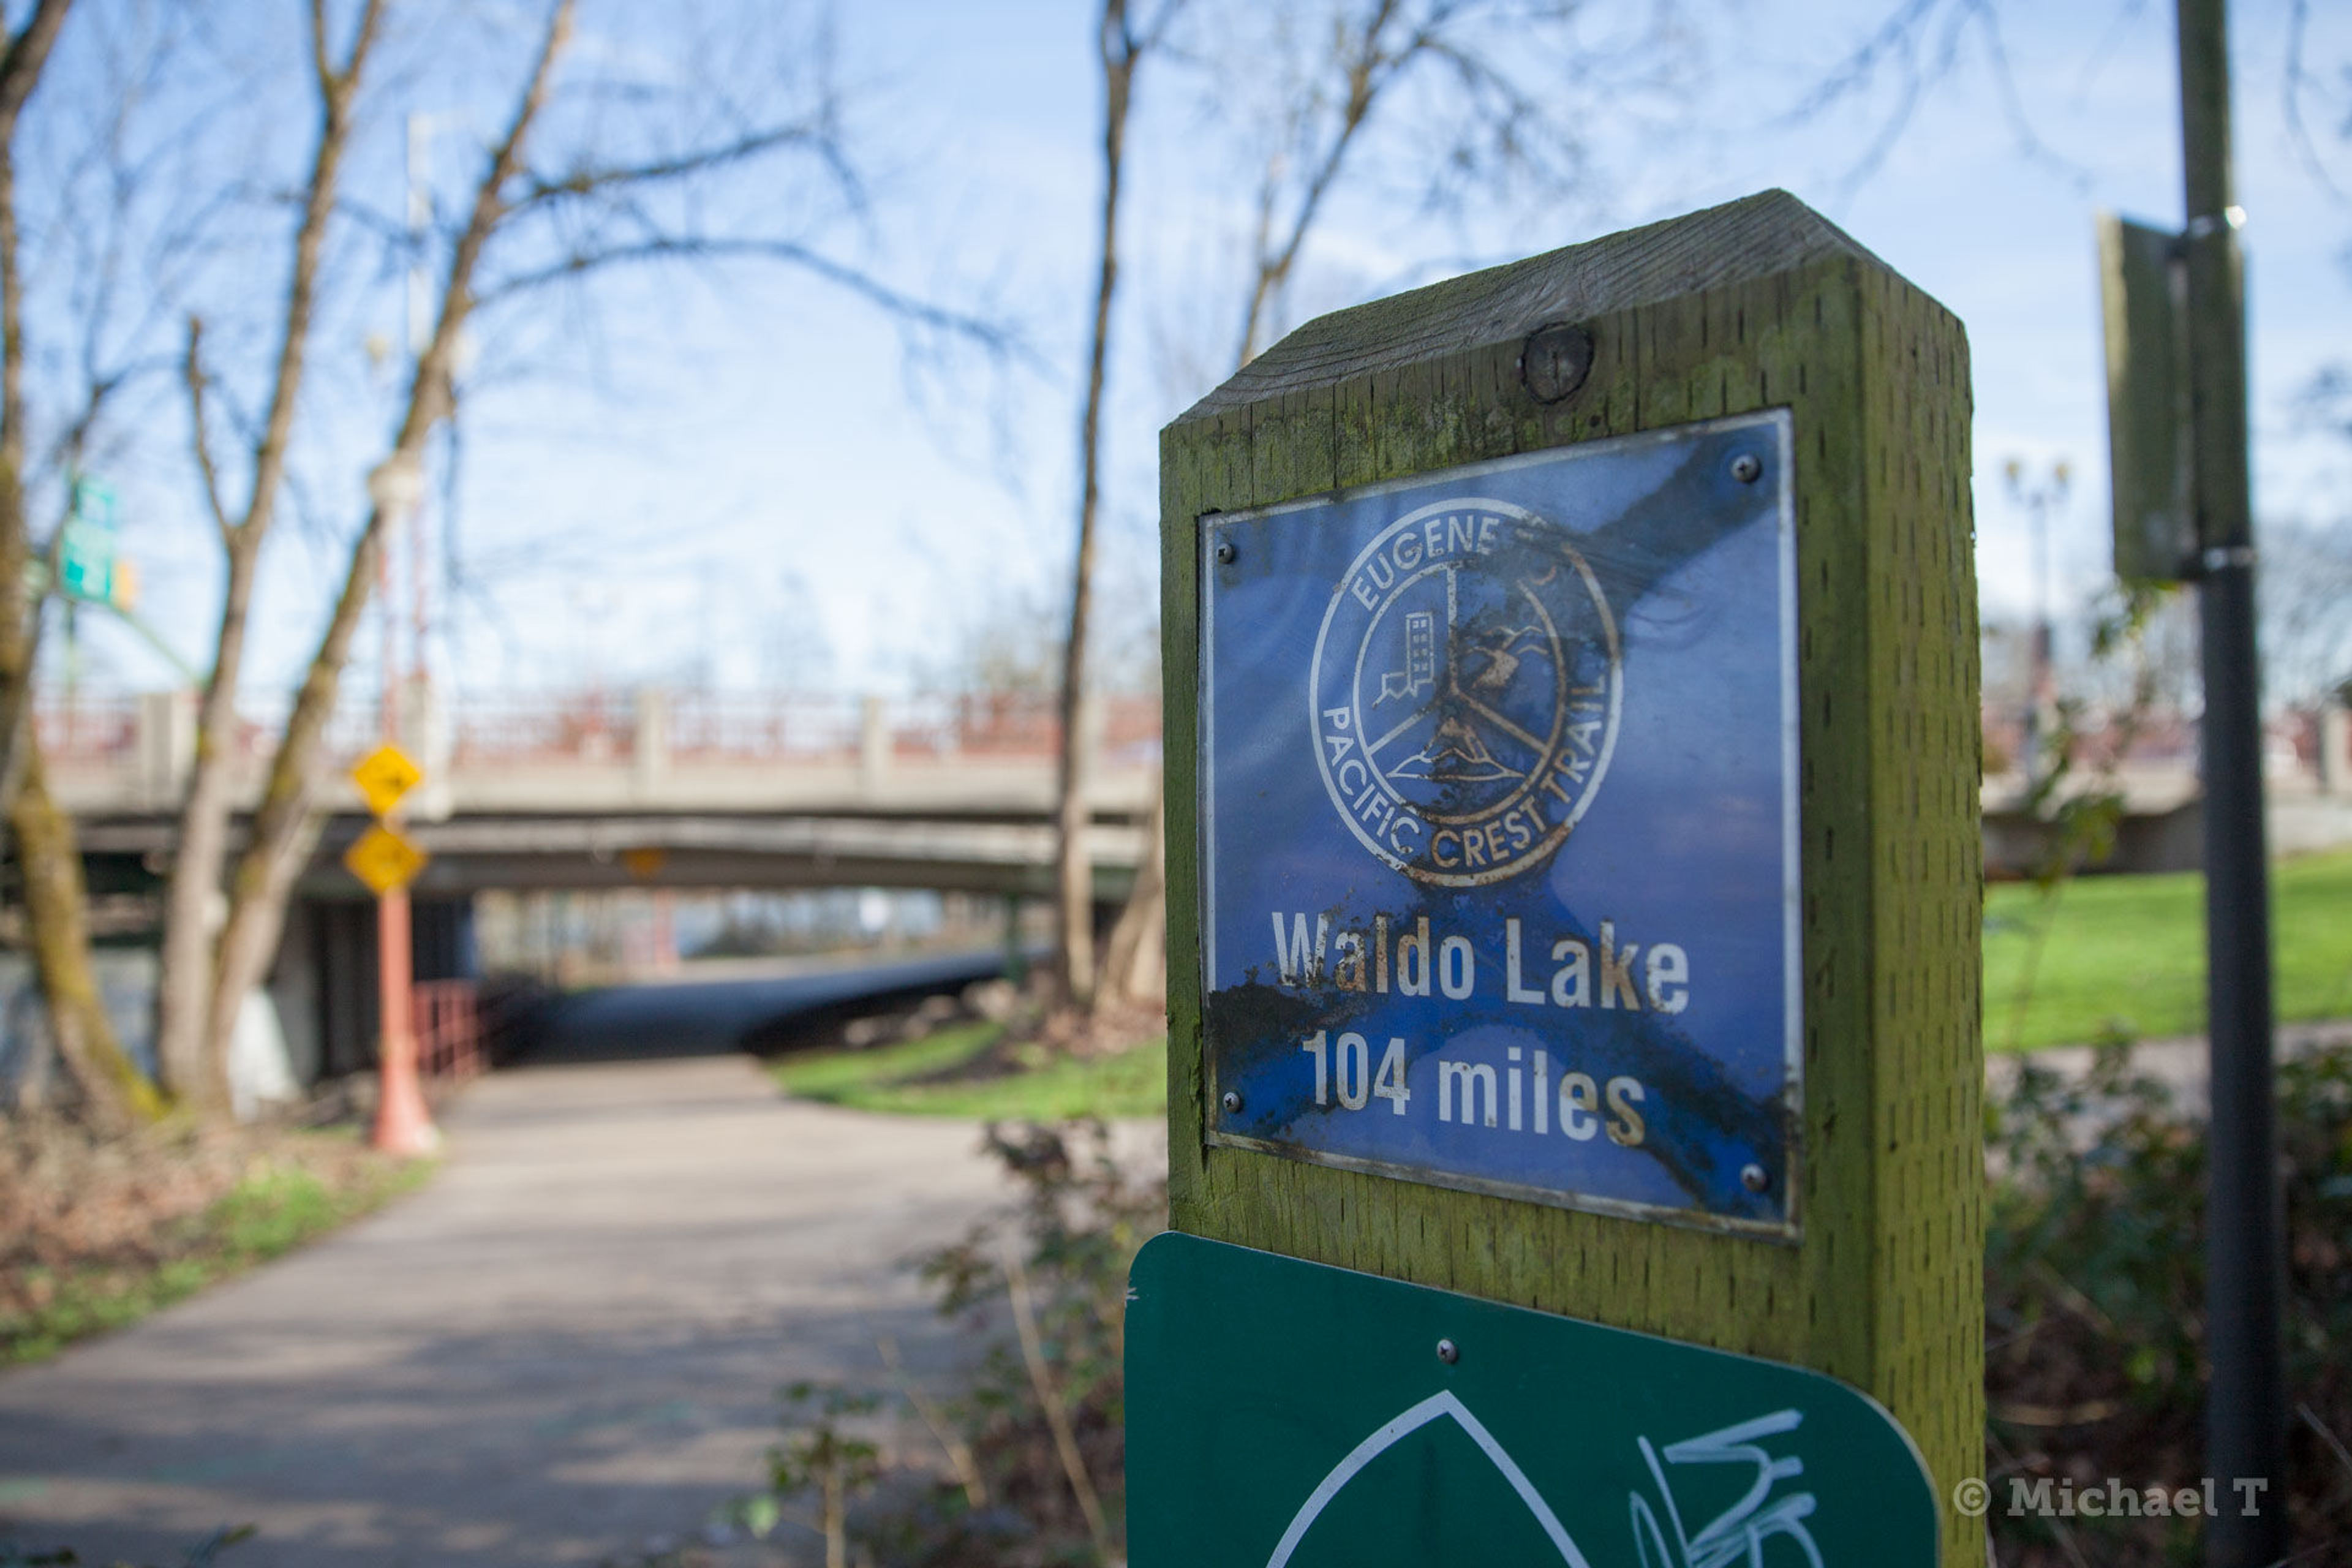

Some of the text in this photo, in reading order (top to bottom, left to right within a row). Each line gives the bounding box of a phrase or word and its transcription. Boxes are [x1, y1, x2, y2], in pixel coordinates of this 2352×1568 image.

[1351, 515, 1499, 611] EUGENE
[1323, 672, 1606, 868] PACIFIC CREST TRAIL
[1272, 911, 1689, 1015] Waldo Lake
[1303, 1030, 1646, 1147] 104 miles
